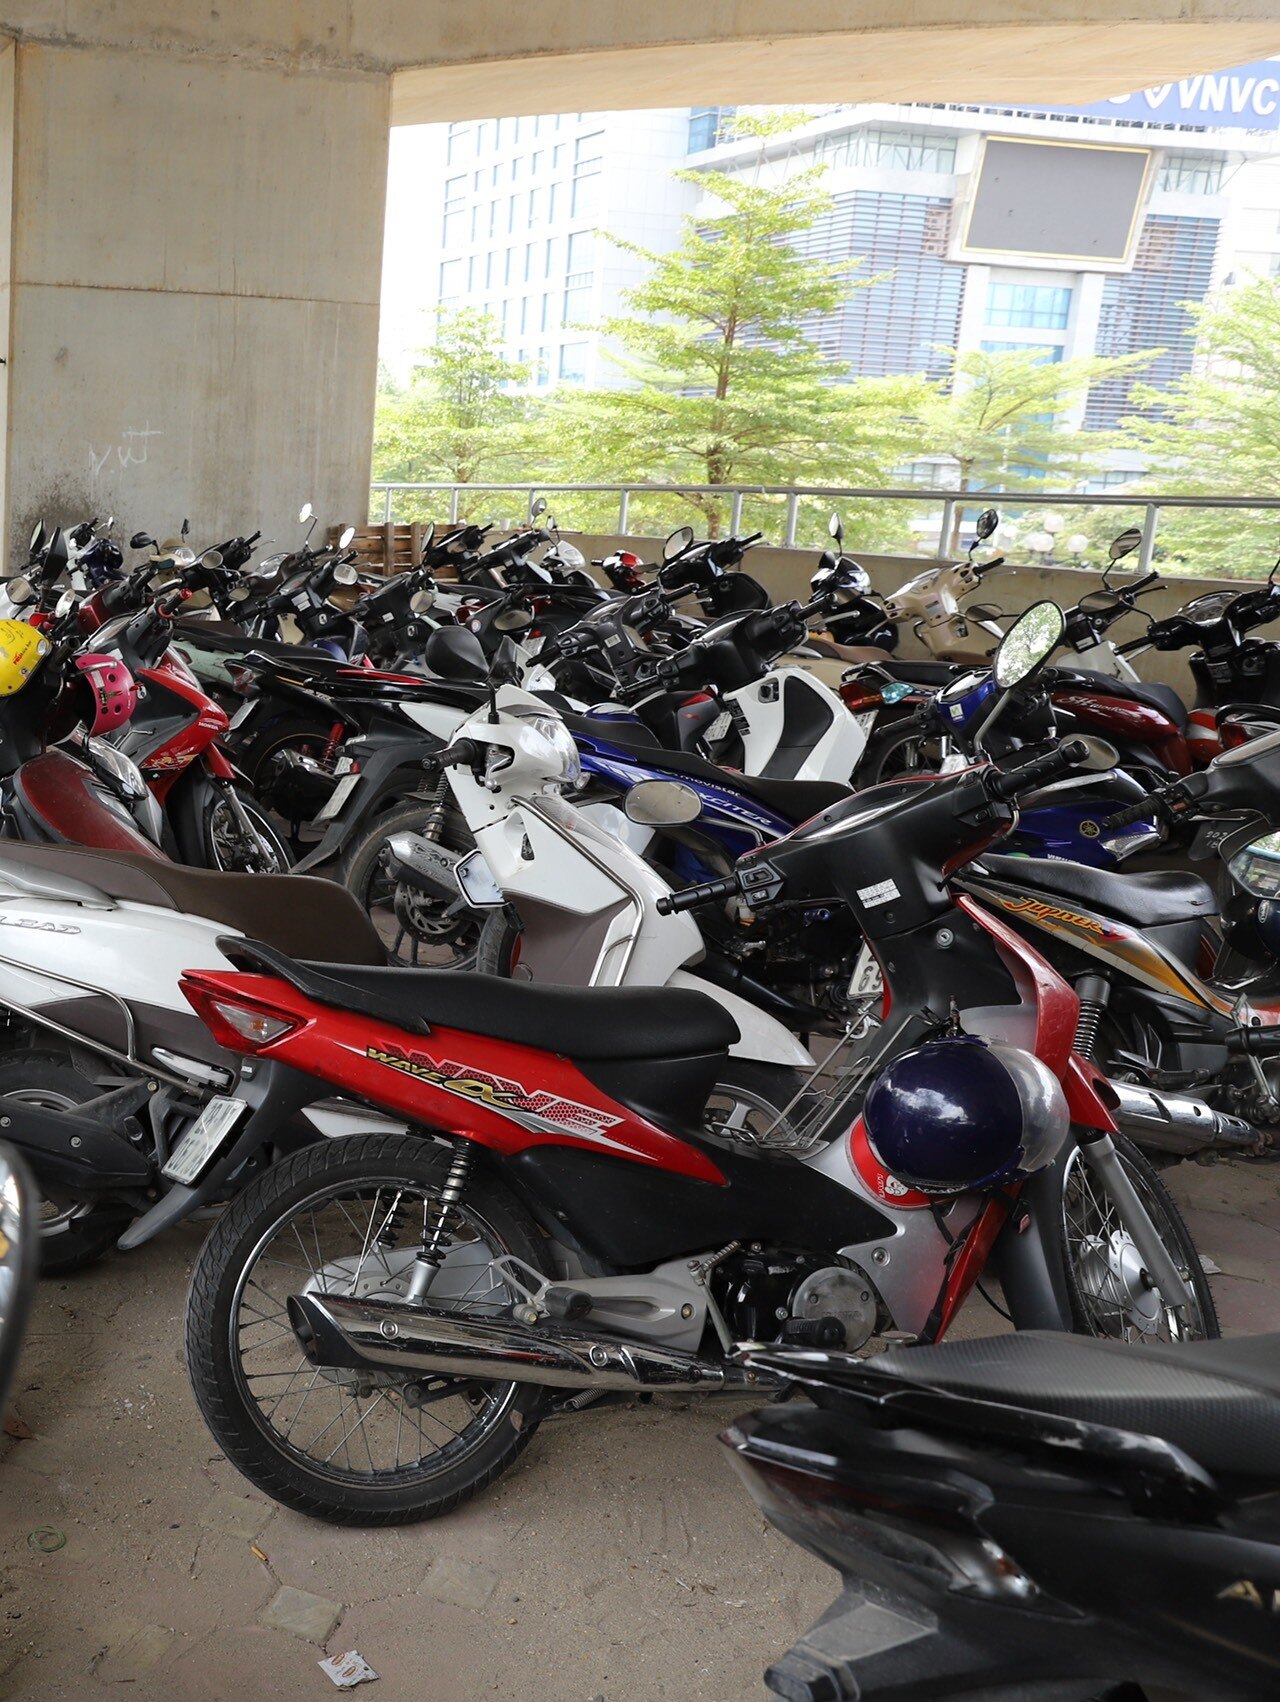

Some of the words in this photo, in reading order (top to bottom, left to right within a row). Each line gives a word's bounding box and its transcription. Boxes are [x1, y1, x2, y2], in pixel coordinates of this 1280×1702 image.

[1178, 74, 1279, 116] VNVC
[680, 775, 741, 797] movistar
[699, 792, 772, 826] XCITER
[367, 1047, 449, 1084] WAVE
